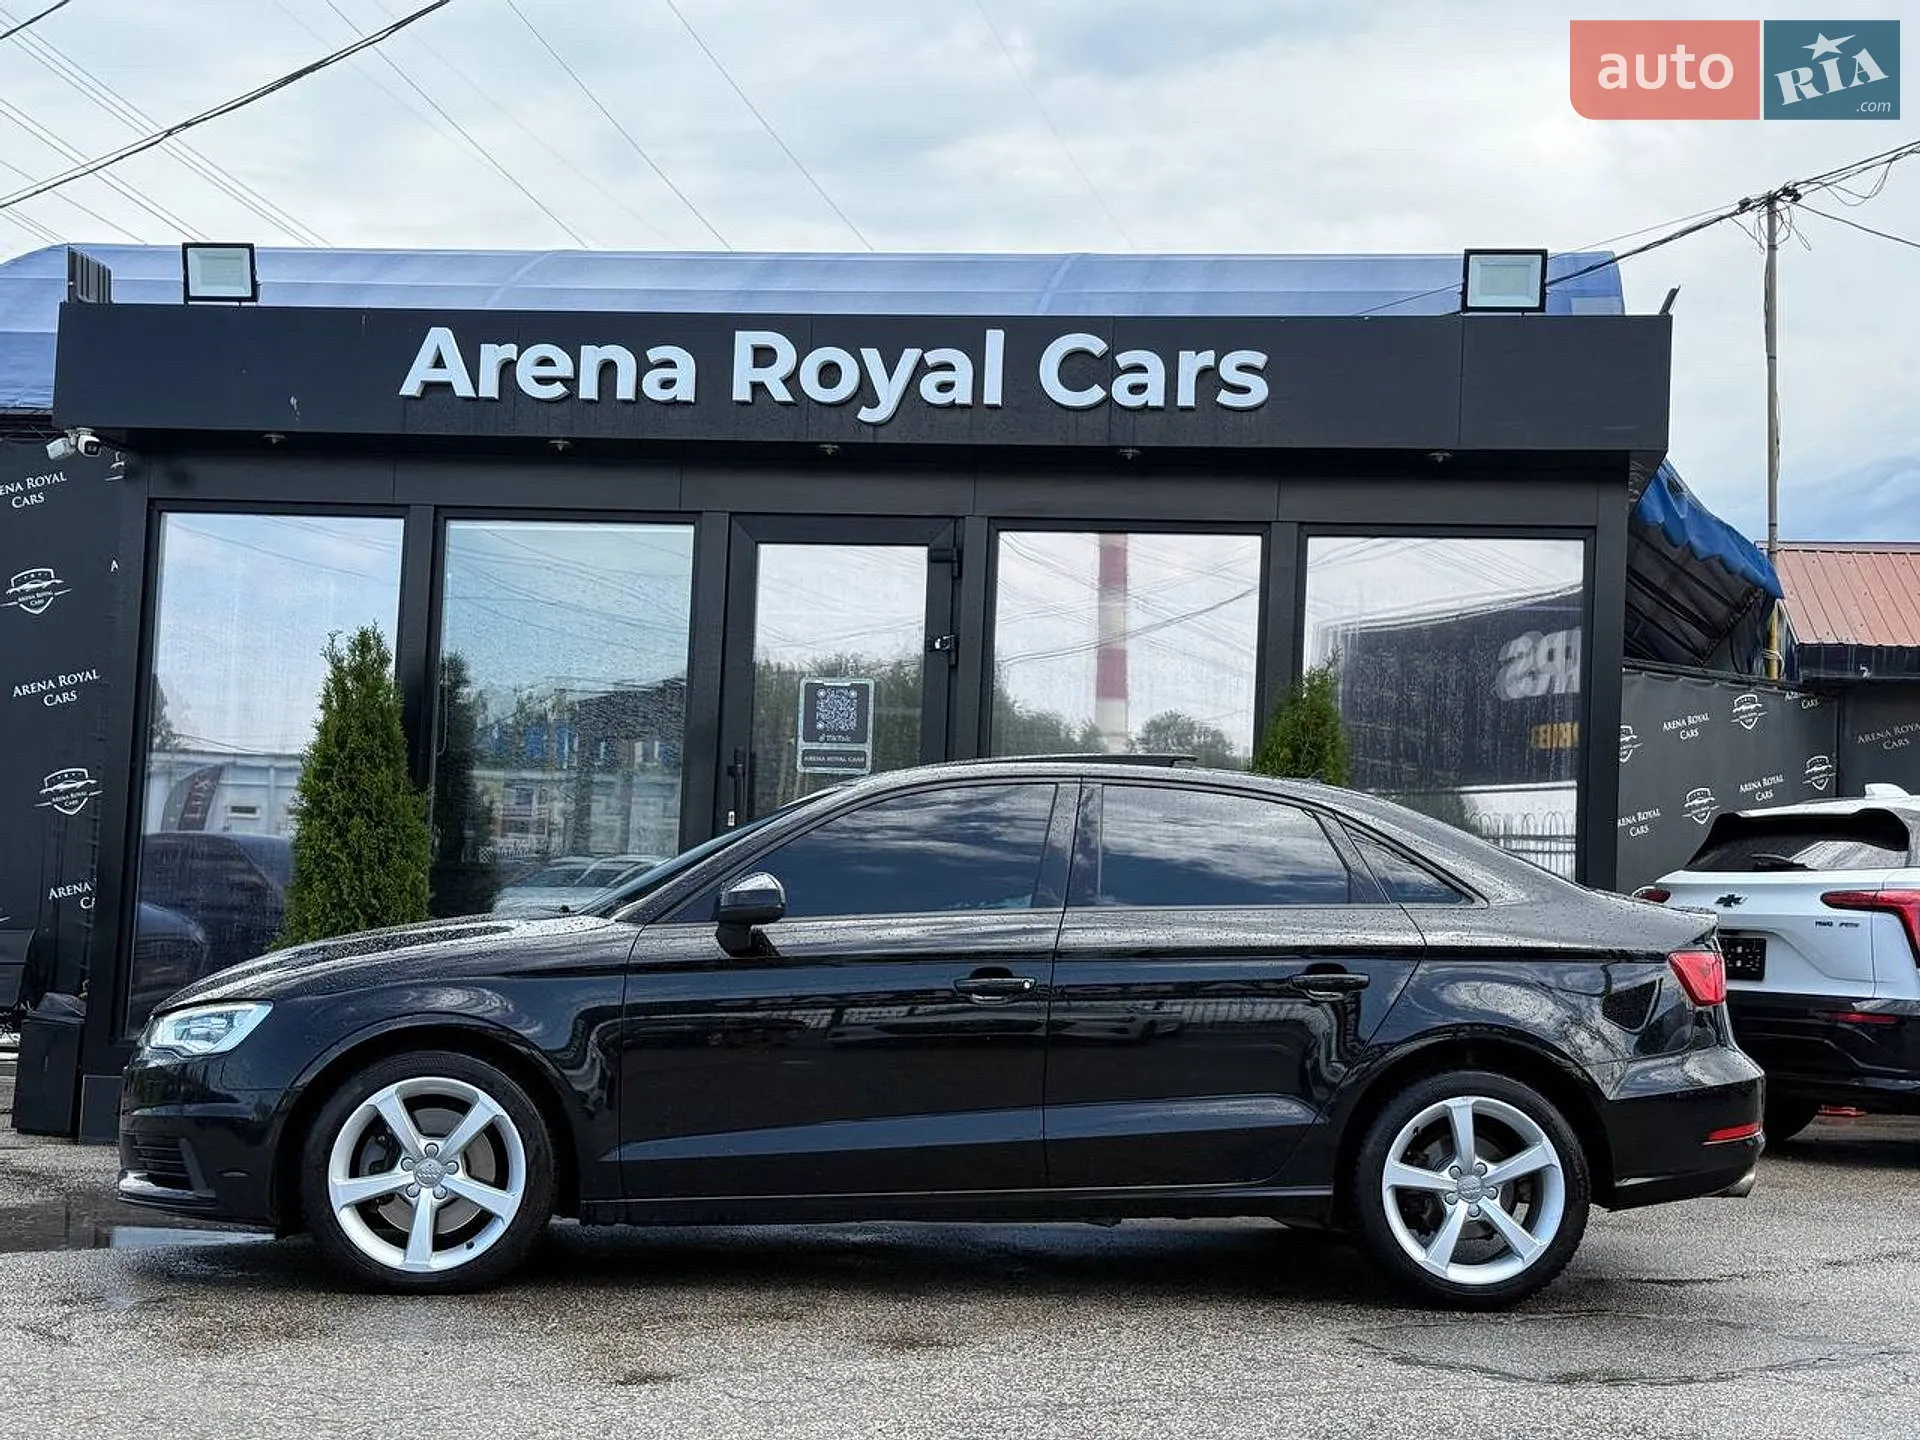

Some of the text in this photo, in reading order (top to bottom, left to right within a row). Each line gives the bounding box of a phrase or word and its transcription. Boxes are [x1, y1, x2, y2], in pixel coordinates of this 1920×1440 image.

[399, 327, 1269, 425] Arena Royal Cars
[0, 471, 67, 496] ENA ROYAL
[12, 491, 45, 508] CARS
[12, 668, 100, 698] ARENA ROYAL
[43, 690, 78, 707] CARS
[1662, 712, 1710, 732] ARENA ROYAL
[1679, 729, 1700, 740] CARS
[1858, 722, 1920, 744] ARENA ROYA
[1882, 738, 1910, 750] CARS
[1739, 774, 1784, 793] ARENA ROYAL
[1755, 790, 1773, 801] CARS
[1617, 815, 1638, 827] RENA
[48, 881, 92, 901] ARENA
